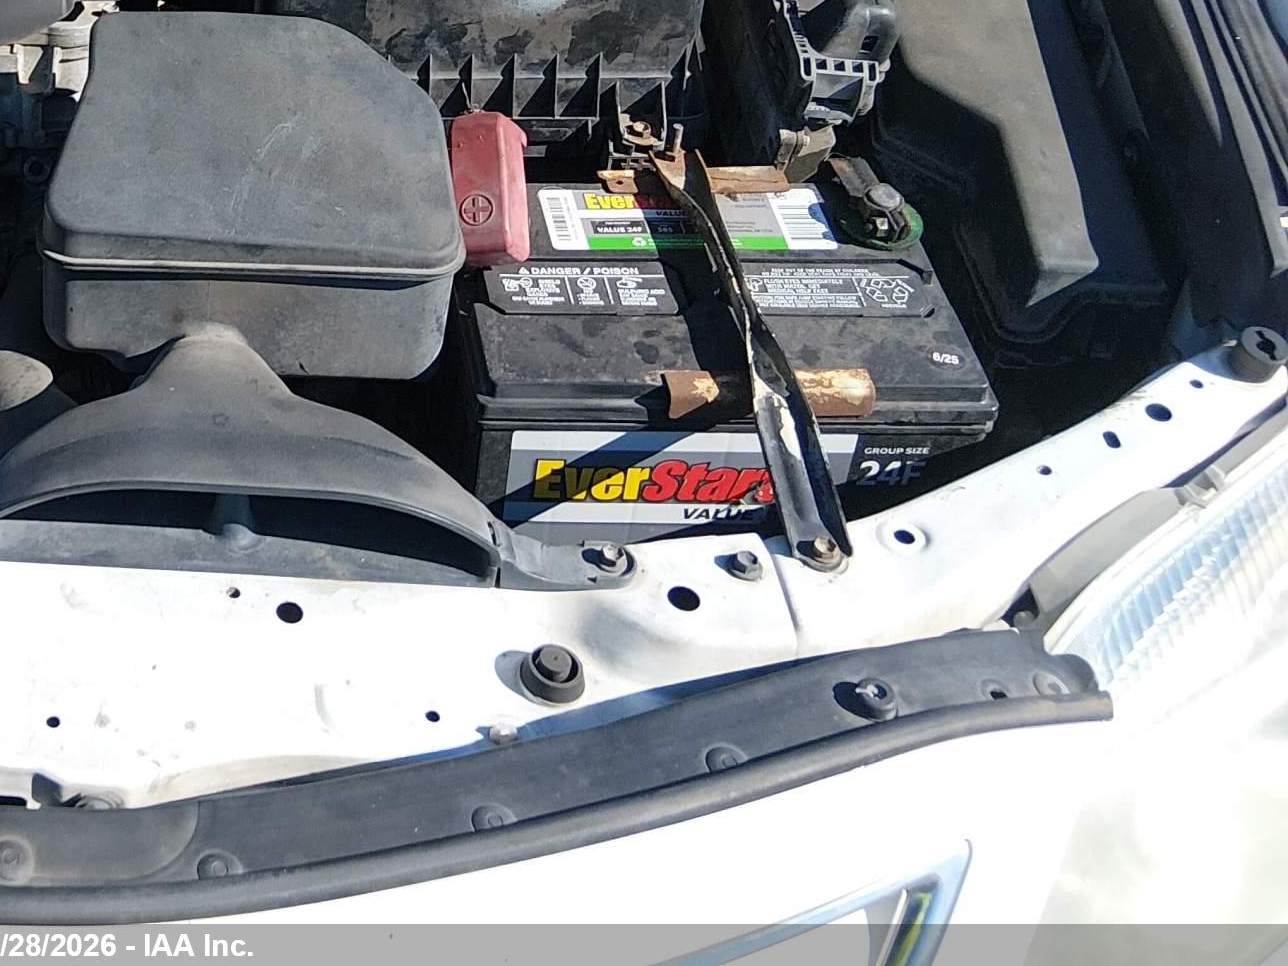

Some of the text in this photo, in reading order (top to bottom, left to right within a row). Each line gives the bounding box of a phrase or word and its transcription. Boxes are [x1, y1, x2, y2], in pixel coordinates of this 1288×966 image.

[530, 267, 640, 275] DANGER / POISON
[932, 352, 960, 365] 6/25
[864, 446, 930, 455] GROUP SIZE
[856, 460, 926, 485] 24F
[683, 507, 755, 521] VALUE
